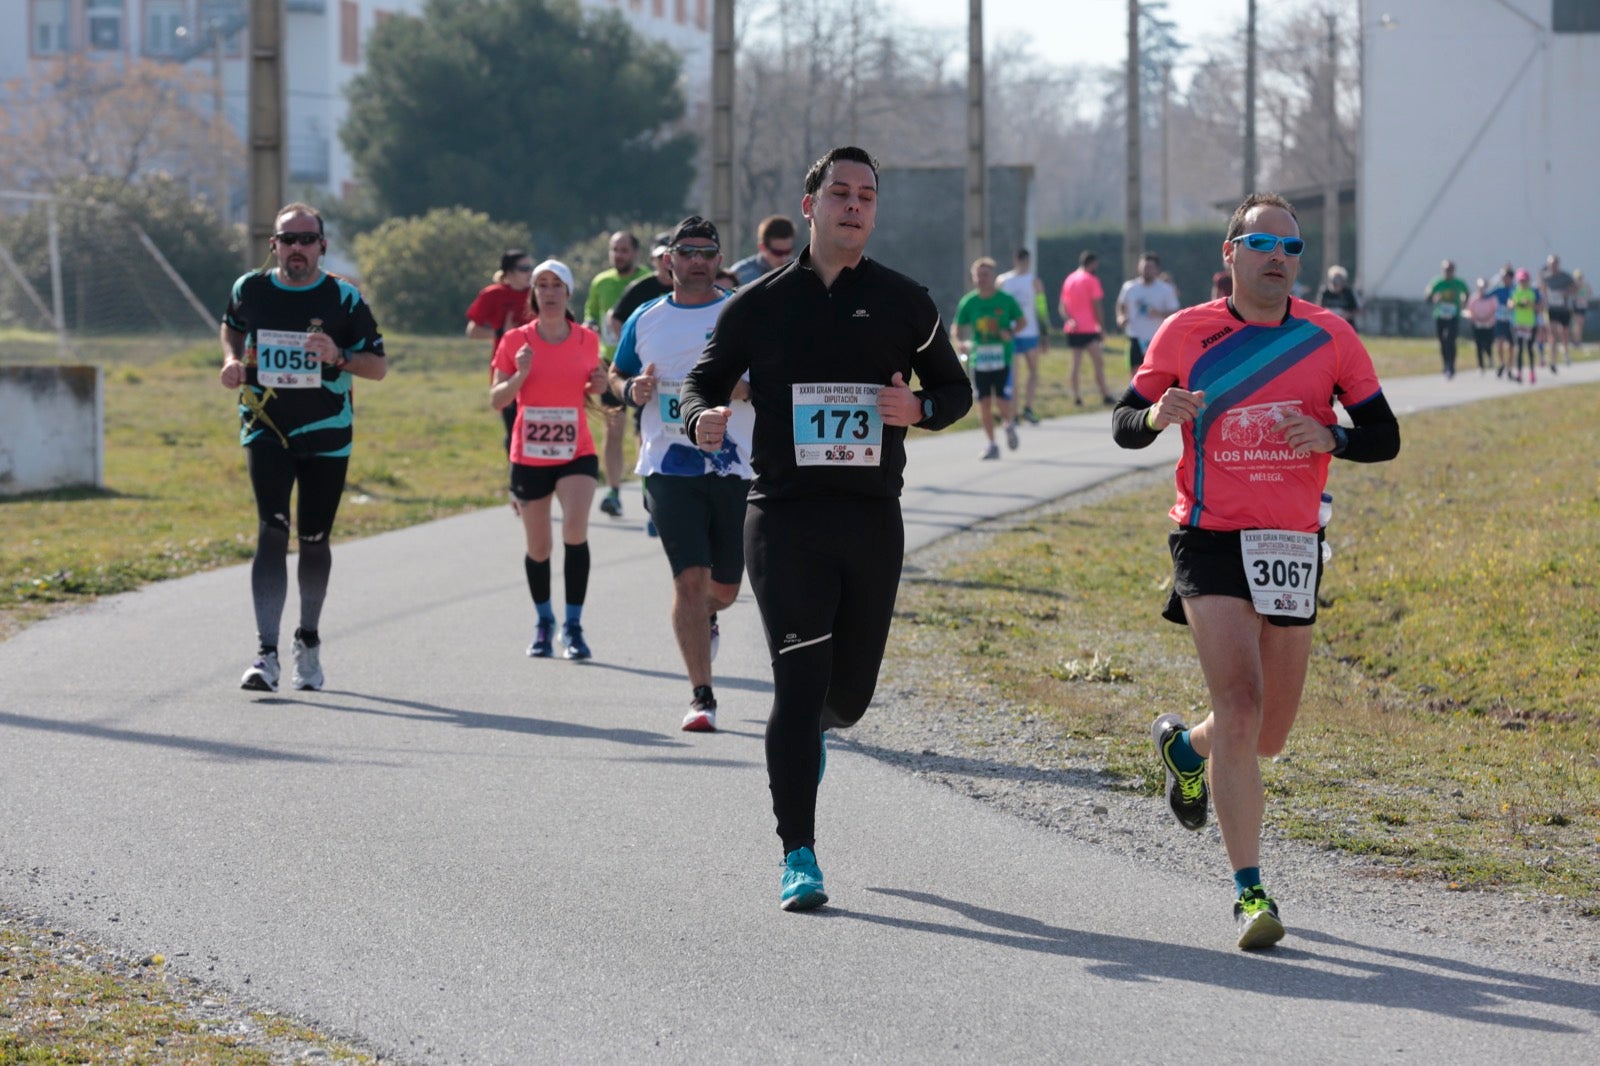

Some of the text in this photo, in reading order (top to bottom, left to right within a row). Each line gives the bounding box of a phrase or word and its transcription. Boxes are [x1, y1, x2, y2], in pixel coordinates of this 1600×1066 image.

[261, 347, 318, 370] 1058
[816, 386, 832, 394] GRAN
[833, 386, 854, 395] PREMIO
[855, 386, 862, 395] DE
[527, 423, 576, 442] 2229
[810, 409, 869, 440] 173
[1214, 450, 1240, 462] LOS
[1252, 559, 1313, 589] 3067
